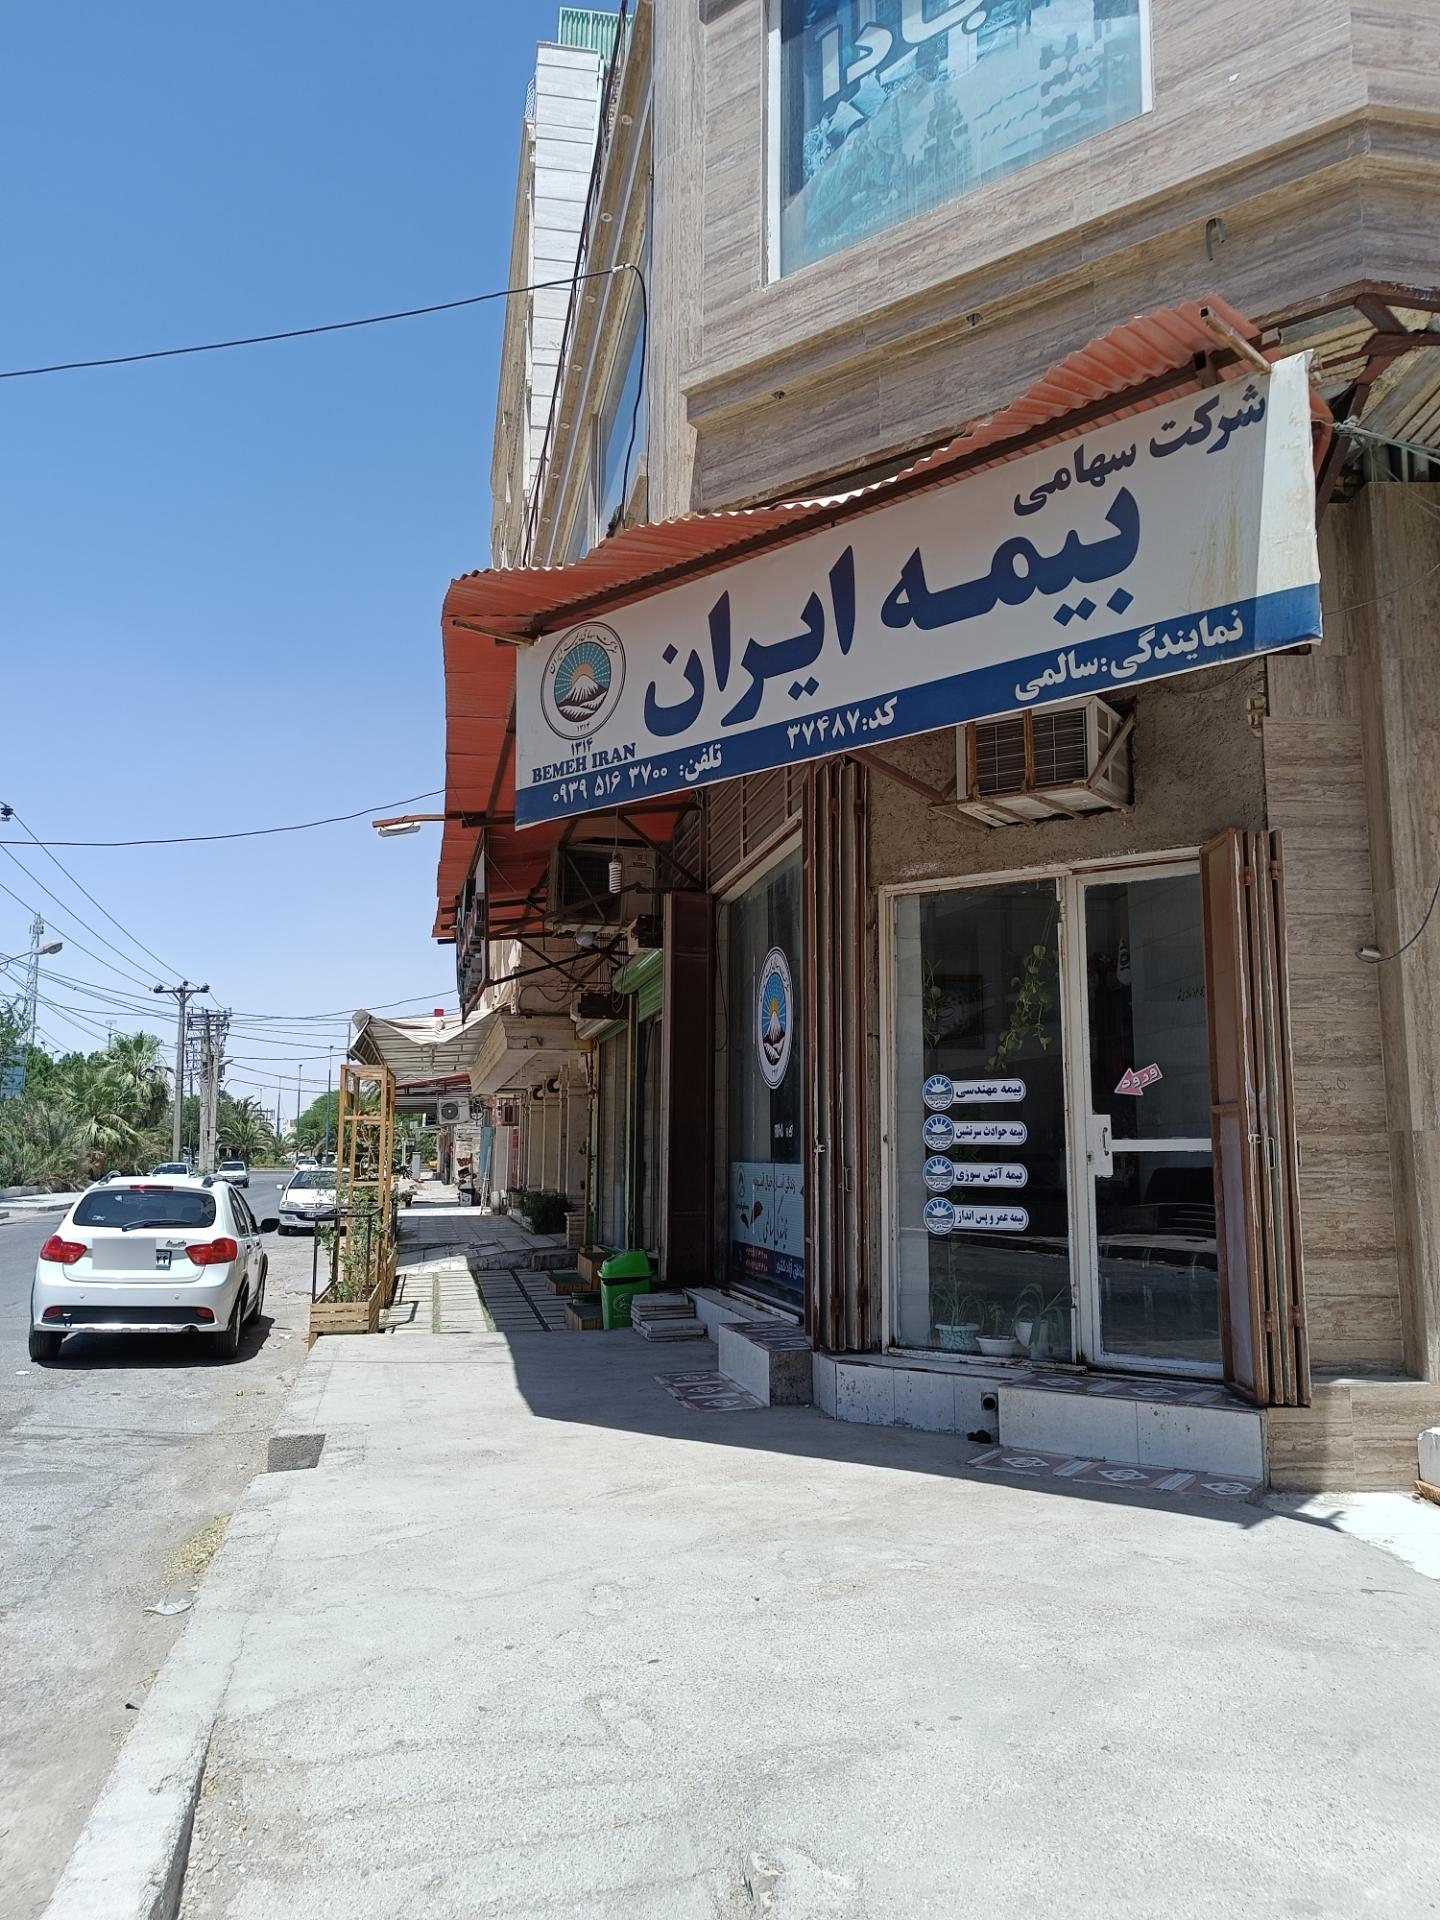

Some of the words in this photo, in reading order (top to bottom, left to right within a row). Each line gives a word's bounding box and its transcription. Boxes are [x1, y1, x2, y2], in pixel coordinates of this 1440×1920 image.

[1149, 384, 1267, 458] شرکت
[1012, 436, 1137, 517] سهامی
[881, 486, 1142, 631] بیمه
[643, 545, 857, 738] ایران
[570, 738, 593, 755] ۱۳۱۴
[532, 755, 587, 784] BEMEH
[592, 743, 637, 767] IRAN
[679, 743, 722, 782] تلفن:
[628, 763, 668, 788] ۳۷۰۰
[553, 779, 588, 804] ۰۹۳۹
[594, 771, 621, 797] ۵۱۶
[1121, 1067, 1159, 1089] ورود
[956, 1085, 998, 1098] مهندسی
[1001, 1084, 1022, 1096] بیمه
[956, 1125, 982, 1139] سرنشین
[983, 1126, 1007, 1139] حوادث
[1009, 1127, 1024, 1139] بیمه
[956, 1169, 980, 1182] سوزی
[983, 1167, 1003, 1182] آتش
[1006, 1170, 1023, 1183] بیمه
[957, 1209, 975, 1224] انداز
[975, 1213, 988, 1225] پس
[989, 1215, 994, 1225] و
[995, 1213, 1008, 1225] عمر
[1010, 1213, 1024, 1225] بیمه
